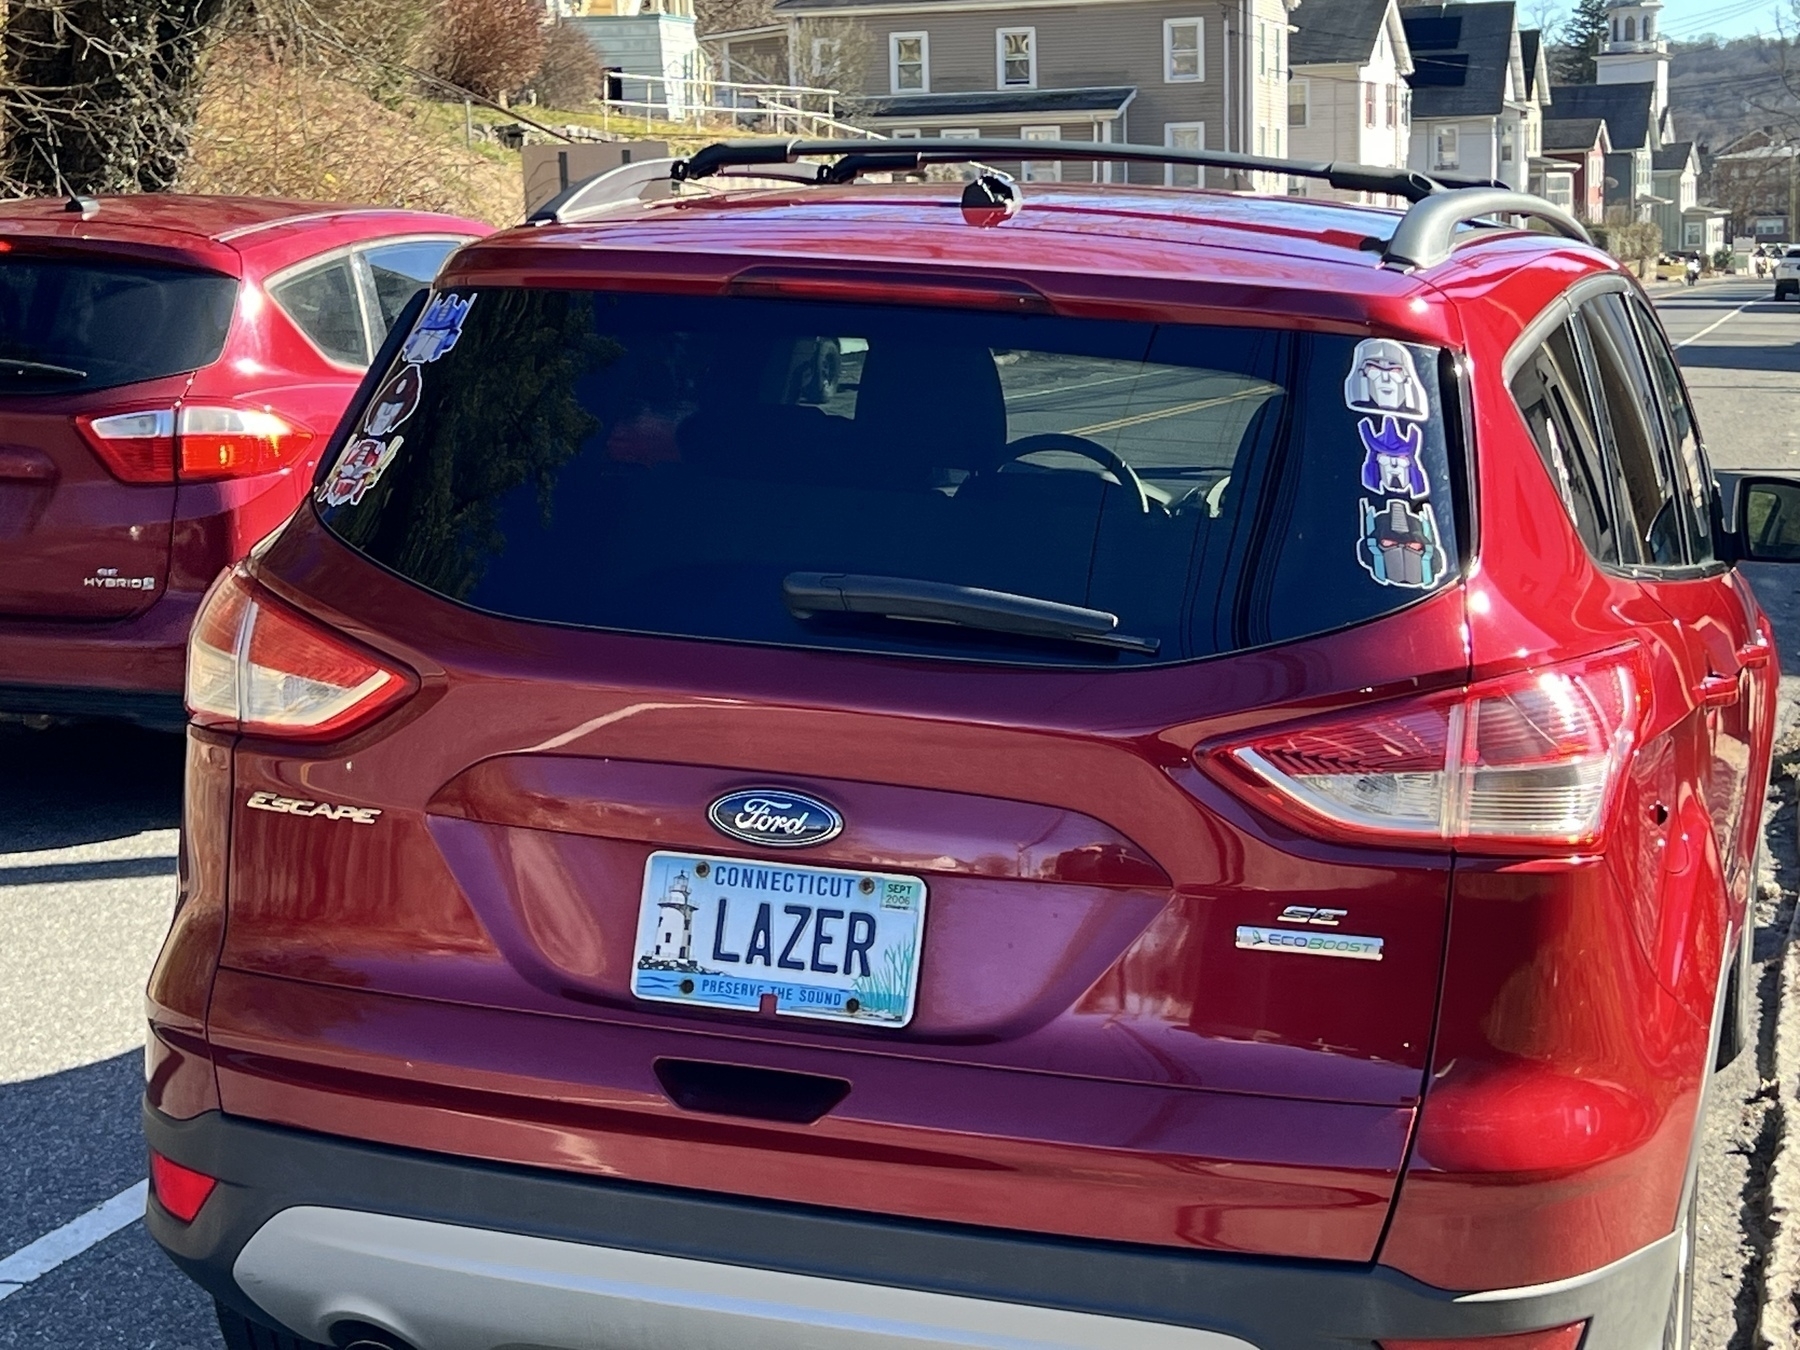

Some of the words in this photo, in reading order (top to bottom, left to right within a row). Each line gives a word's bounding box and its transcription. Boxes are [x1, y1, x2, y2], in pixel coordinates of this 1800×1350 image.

[84, 577, 142, 589] HYBRID
[247, 791, 382, 824] ESCAPE
[735, 798, 809, 835] Ford
[714, 866, 855, 899] CONNECTICUT
[887, 884, 912, 895] SEPT
[885, 894, 910, 905] 2006
[1276, 905, 1348, 926] SE
[712, 898, 877, 978] LAZER
[1268, 933, 1375, 953] ECOBOOST
[701, 979, 765, 998] PRESERVE
[770, 986, 793, 1000] THE
[799, 989, 842, 1006] SOUND
